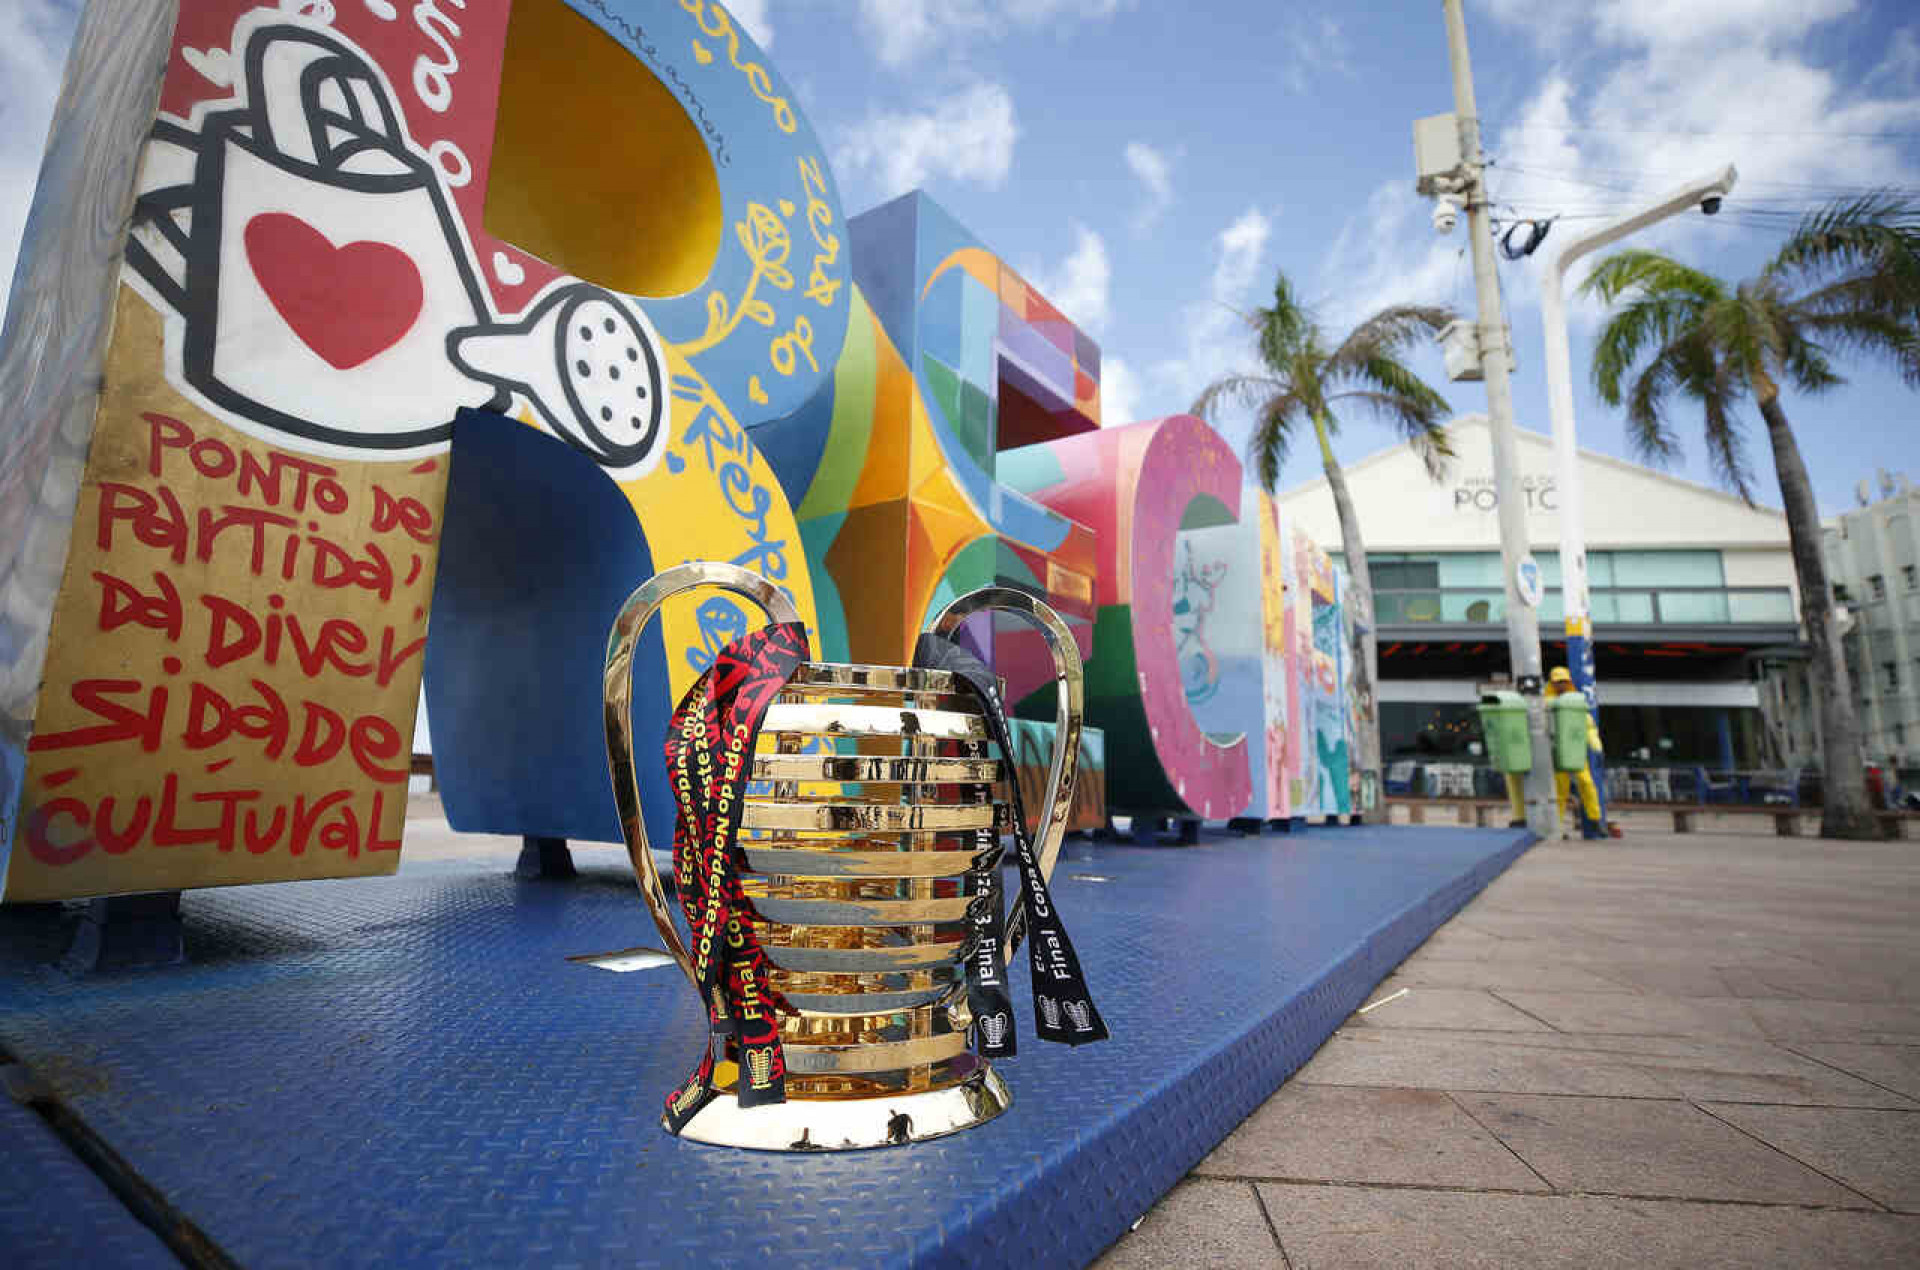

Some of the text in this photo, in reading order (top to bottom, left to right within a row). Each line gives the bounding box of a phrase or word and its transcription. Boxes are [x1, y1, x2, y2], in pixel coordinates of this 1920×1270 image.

[1454, 488, 1559, 511] POTO
[976, 937, 1001, 986] Final
[1039, 929, 1072, 980] Final
[733, 960, 762, 1020] Final
